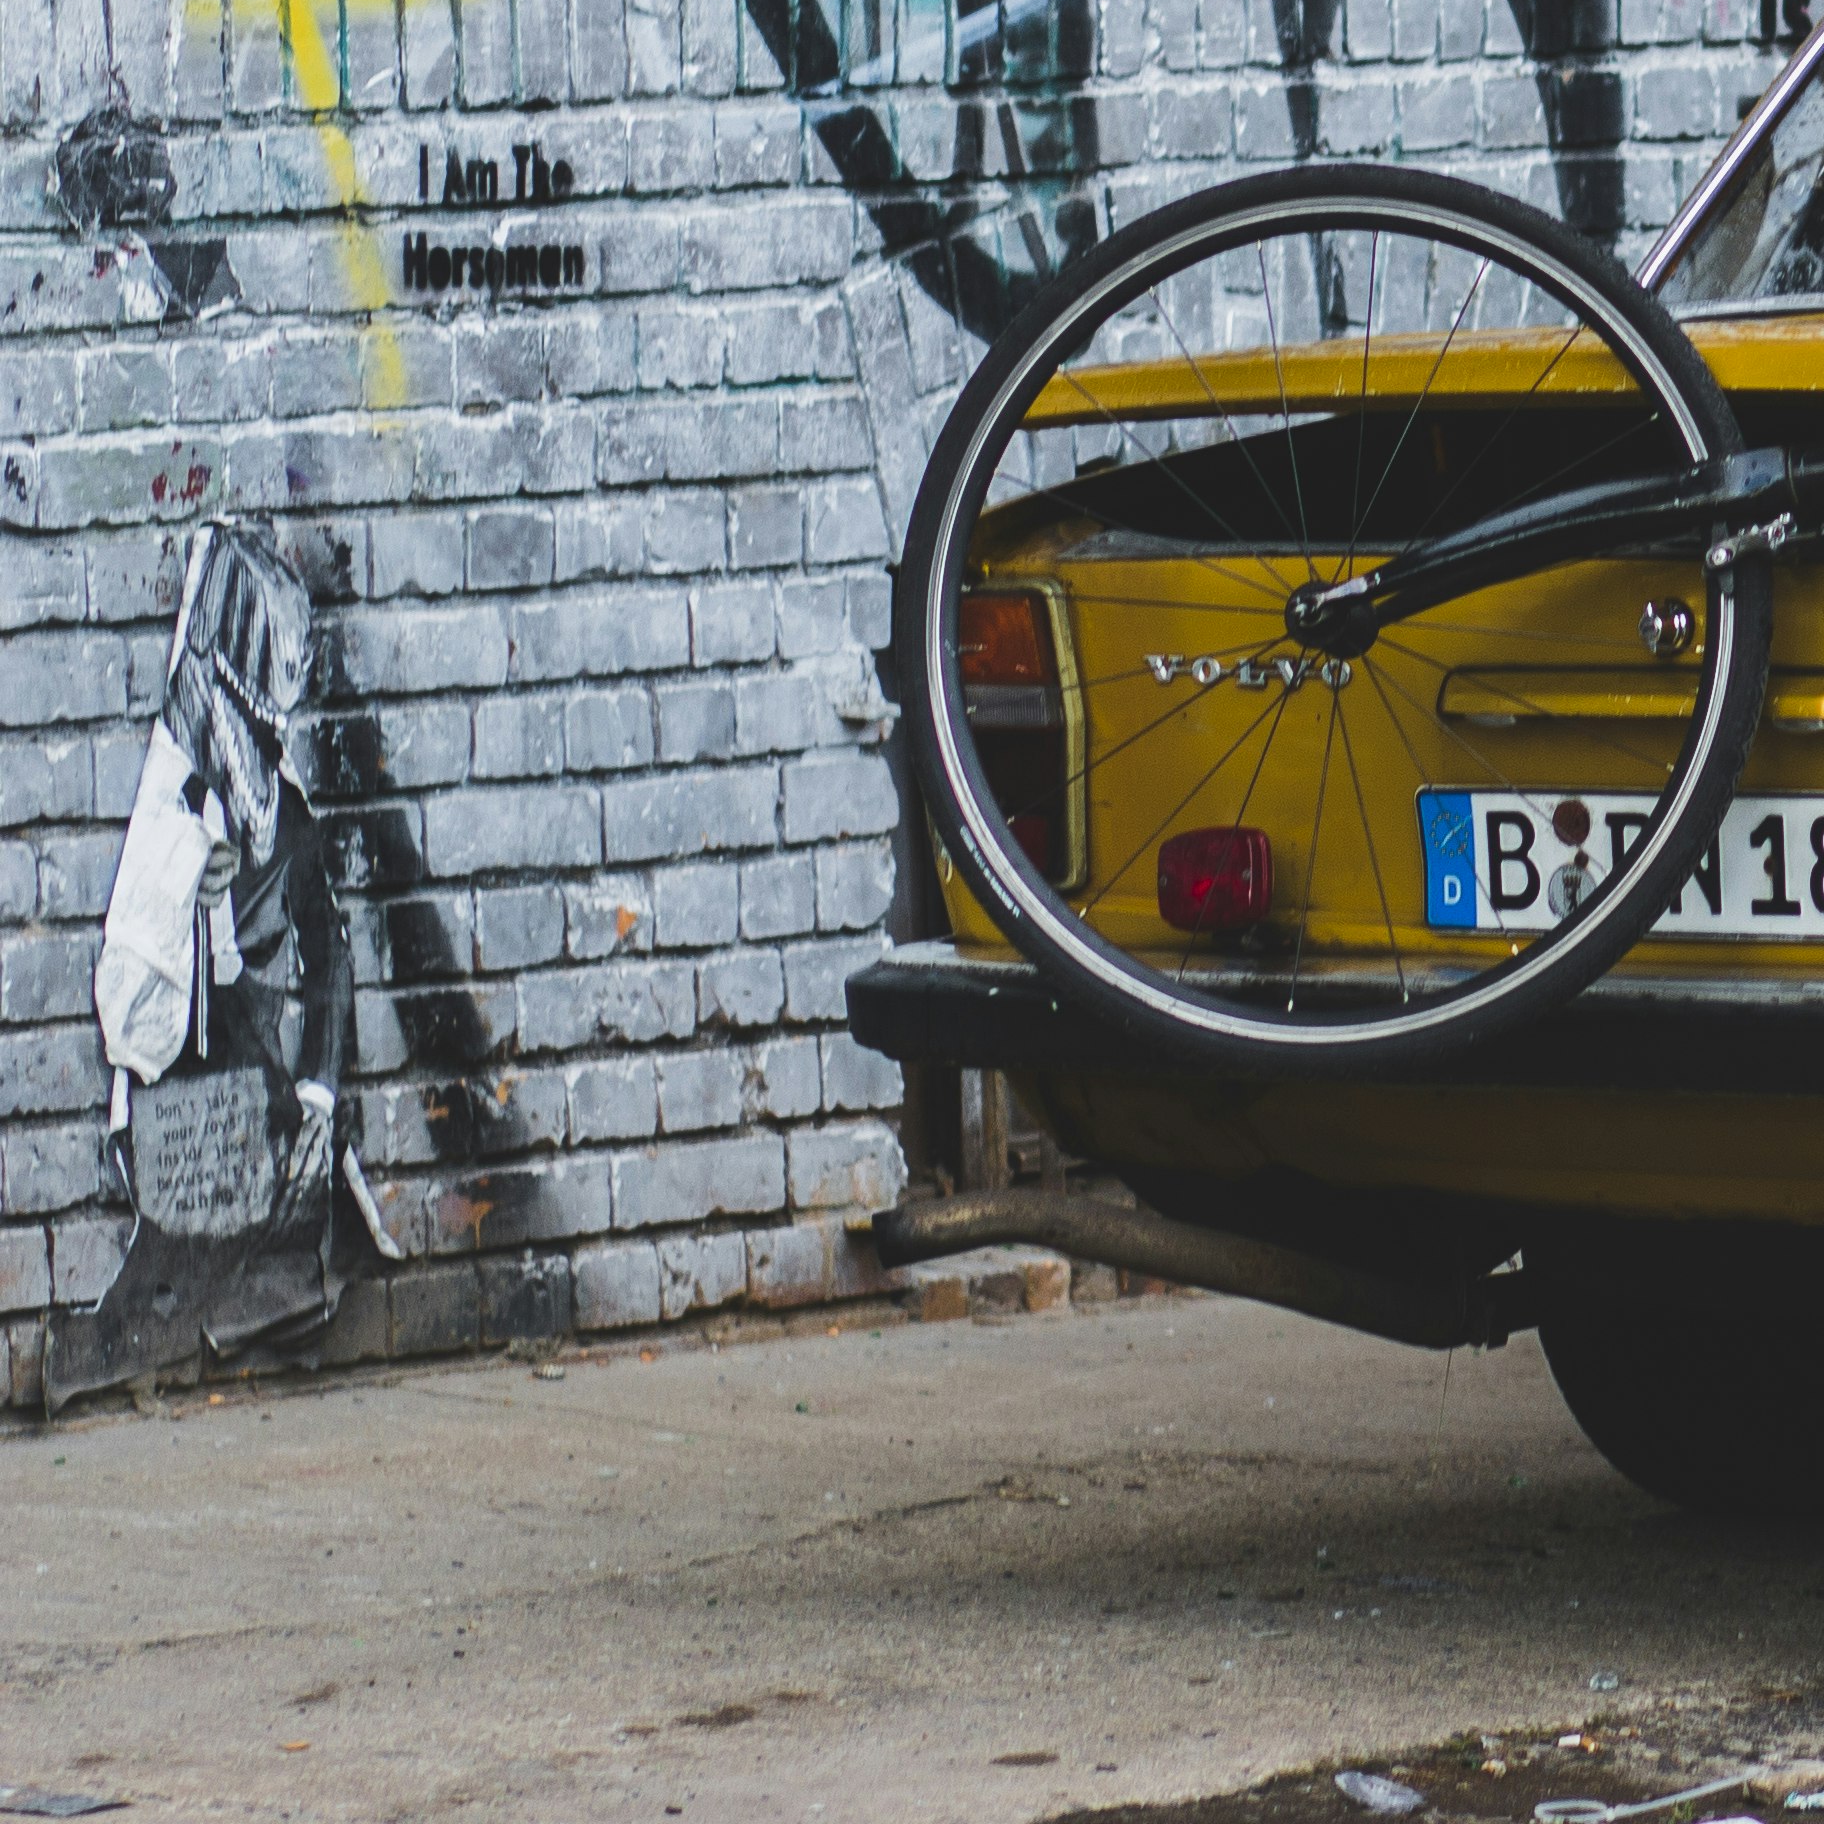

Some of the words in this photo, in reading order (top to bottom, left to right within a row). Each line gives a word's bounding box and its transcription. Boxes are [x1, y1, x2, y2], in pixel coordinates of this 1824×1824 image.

[418, 143, 429, 203] I
[442, 144, 499, 206] Am
[511, 139, 574, 204] The
[403, 231, 584, 291] Horseman
[1143, 653, 1352, 689] VOLVO
[1486, 811, 1542, 912] B
[1443, 875, 1461, 905] D
[163, 1126, 193, 1146] your
